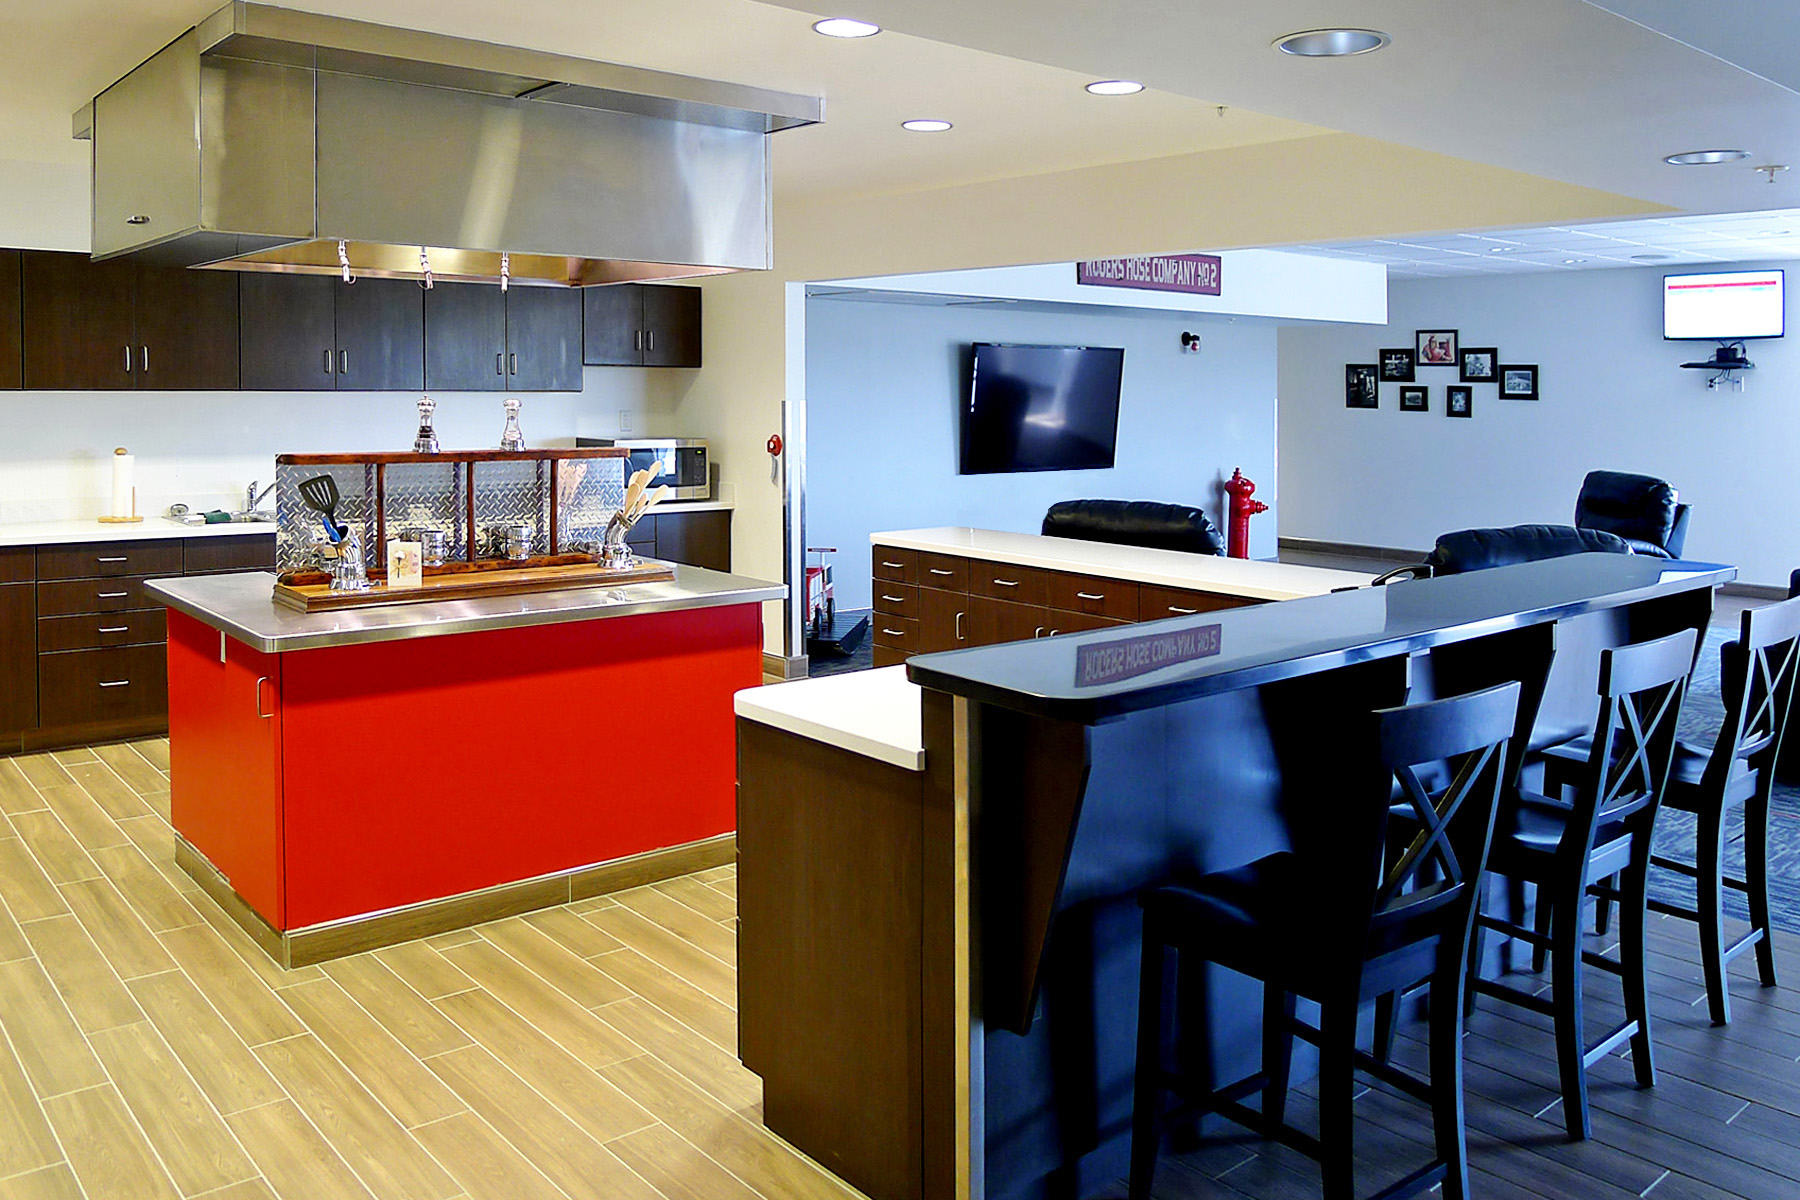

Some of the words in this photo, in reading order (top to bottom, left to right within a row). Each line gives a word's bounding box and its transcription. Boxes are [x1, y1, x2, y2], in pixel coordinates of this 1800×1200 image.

[1127, 258, 1150, 281] HOSE
[1152, 258, 1196, 286] COMPANY
[1210, 263, 1217, 288] 2
